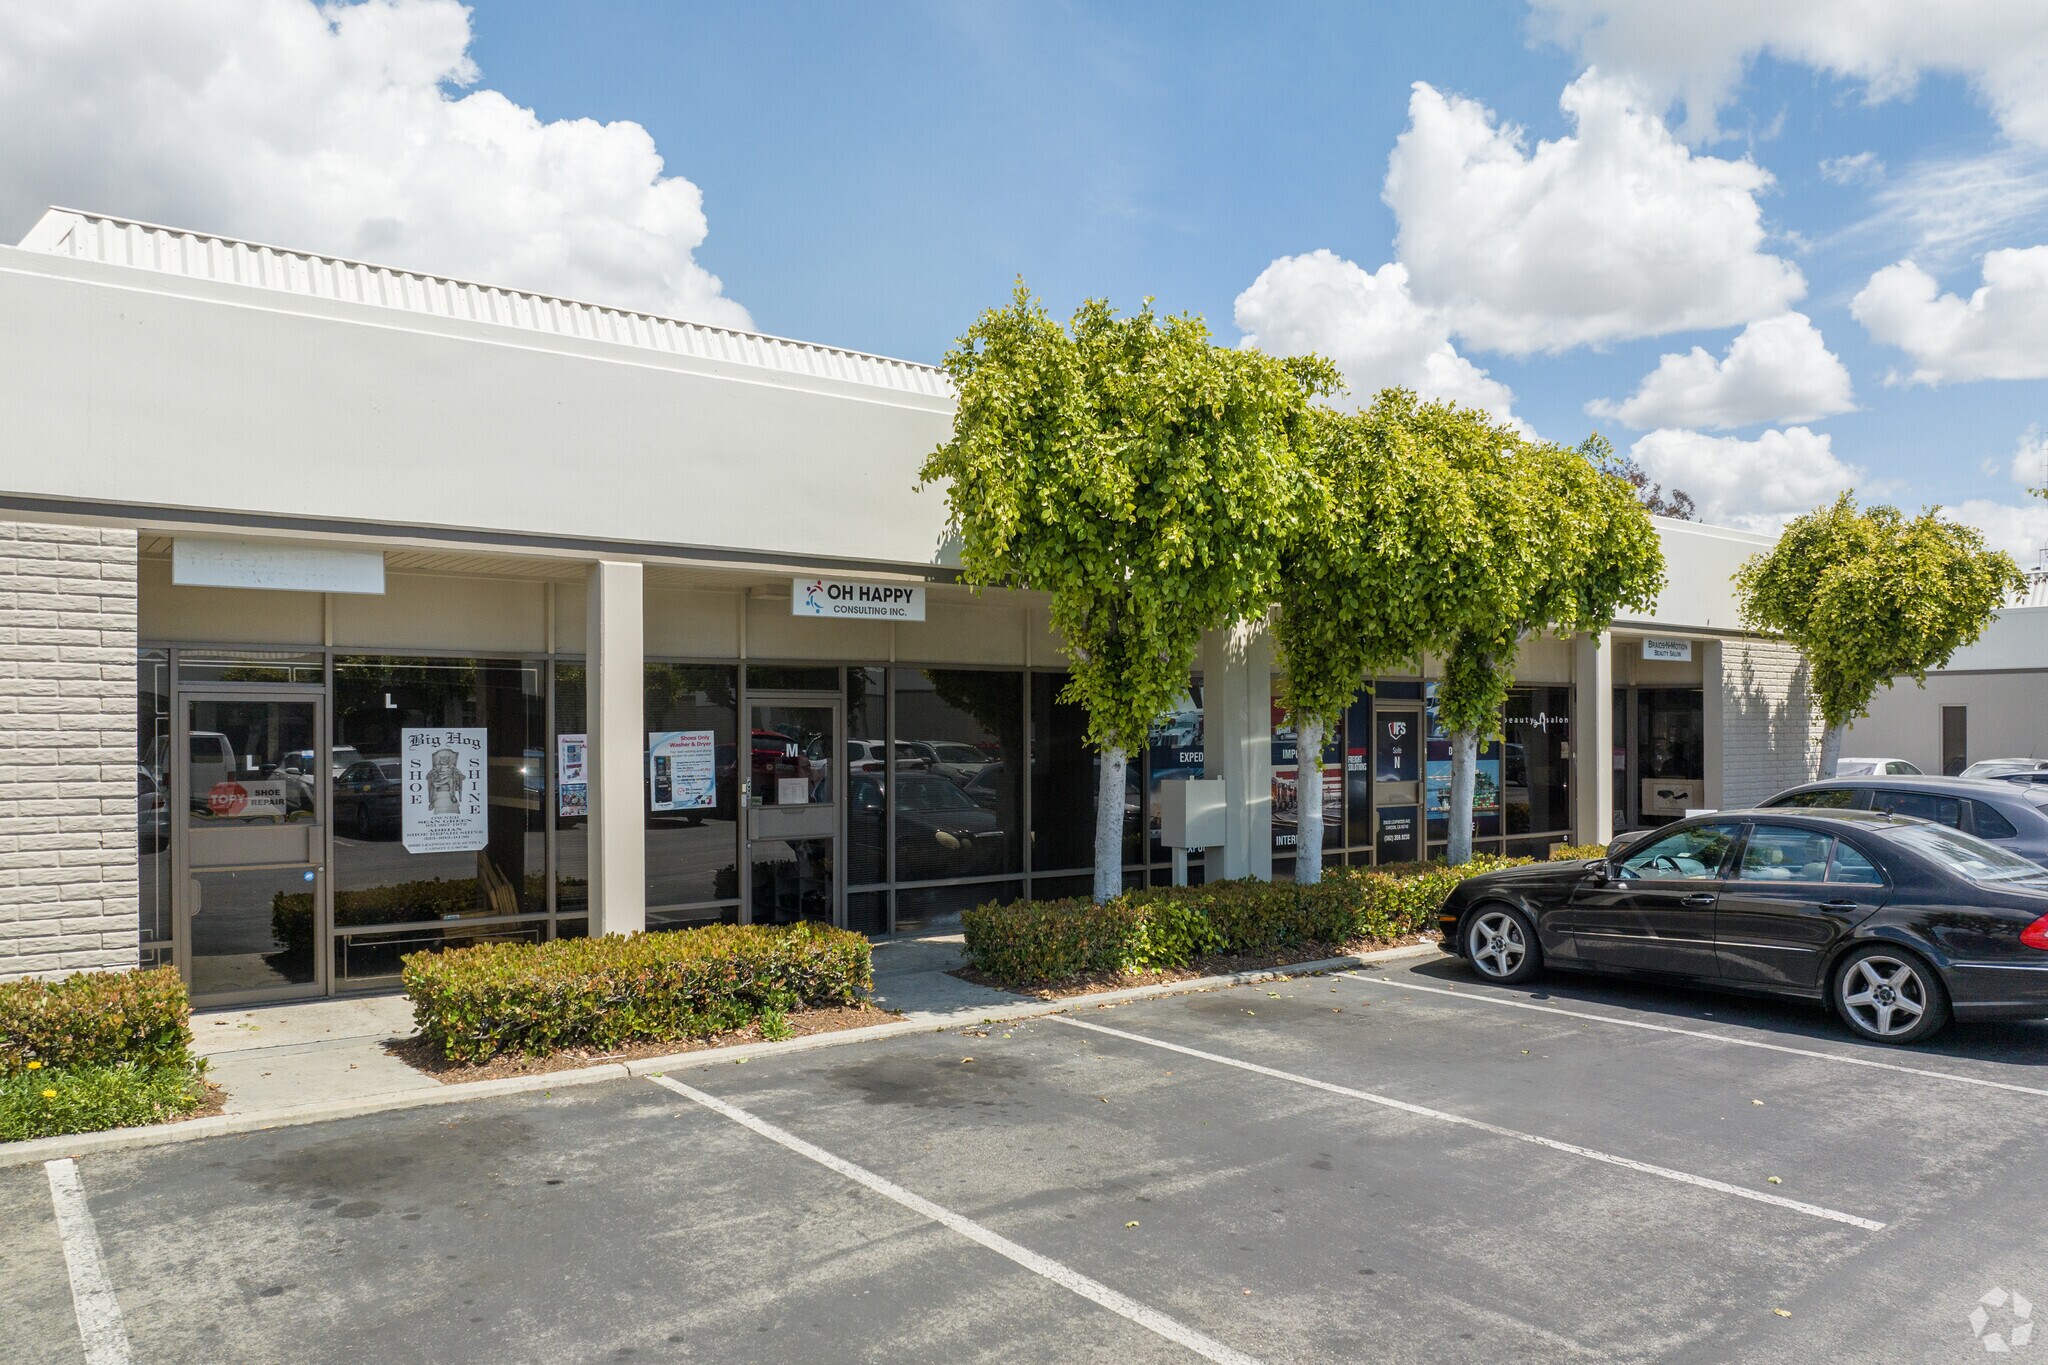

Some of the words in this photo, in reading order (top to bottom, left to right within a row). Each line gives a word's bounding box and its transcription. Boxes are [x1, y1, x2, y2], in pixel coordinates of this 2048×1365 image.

[827, 584, 853, 600] OH
[859, 586, 913, 603] HAPPY
[833, 605, 887, 616] CONSULTING
[889, 608, 907, 616] INC.
[385, 693, 397, 708] L
[1546, 716, 1568, 724] salon
[408, 733, 441, 750] Big
[445, 731, 481, 750] Hog
[786, 743, 798, 757] M
[246, 755, 259, 770] L
[1394, 756, 1400, 768] N
[251, 798, 285, 806] REPAIR
